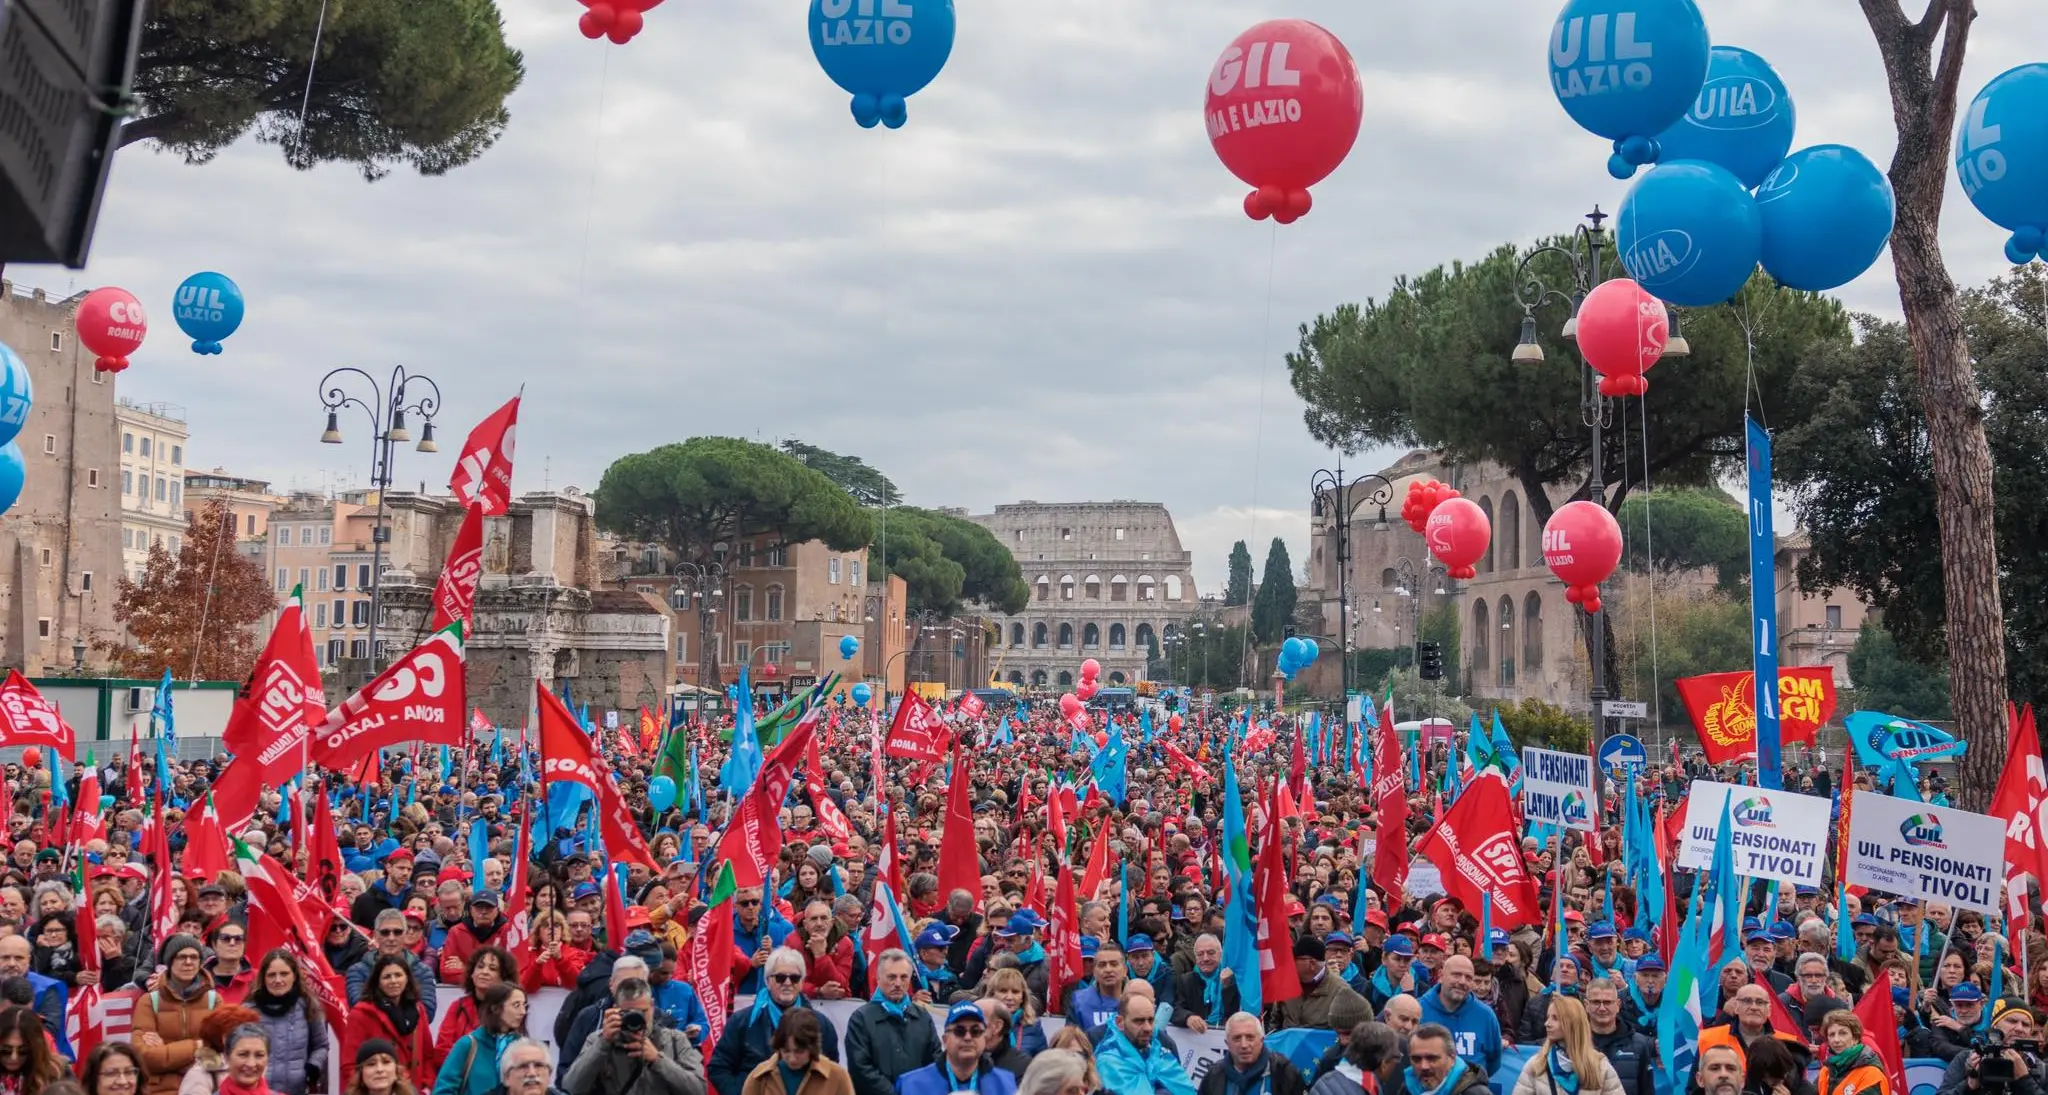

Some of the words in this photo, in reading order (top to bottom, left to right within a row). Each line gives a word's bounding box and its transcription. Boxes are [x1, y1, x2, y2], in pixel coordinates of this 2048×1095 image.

[821, 19, 912, 46] LAZIO
[1553, 12, 1653, 69] UIL
[1205, 41, 1300, 97] GIL
[1553, 62, 1653, 98] LAZIO
[1228, 105, 1241, 131] E
[1242, 98, 1302, 129] LAZIO
[1694, 82, 1757, 120] UILA
[1629, 238, 1680, 282] UILA
[178, 285, 225, 310] UIL
[109, 300, 147, 325] CG
[178, 306, 224, 323] LAZIO
[107, 326, 134, 341] ROMA
[1430, 514, 1453, 525] CGIL
[1542, 530, 1572, 552] GIL
[452, 560, 480, 600] SP
[795, 678, 812, 687] BAR
[1777, 675, 1825, 701] OM
[1, 692, 32, 730] CGIL
[890, 738, 917, 752] ROMA
[1524, 750, 1538, 779] UIL
[1539, 752, 1589, 788] PENSIONATI
[1526, 792, 1561, 821] LATINA
[1570, 804, 1588, 819] UIL
[1747, 809, 1772, 823] UIL
[1692, 825, 1717, 842] UIL
[1731, 831, 1817, 857] ENSIONATI
[1915, 826, 1943, 843] UIL
[1483, 842, 1521, 879] SPI
[1747, 852, 1813, 879] TIVOLI
[1858, 841, 1885, 860] UIL
[1890, 847, 1992, 883] PENSIONATI
[1918, 874, 1990, 906] TIVOLI
